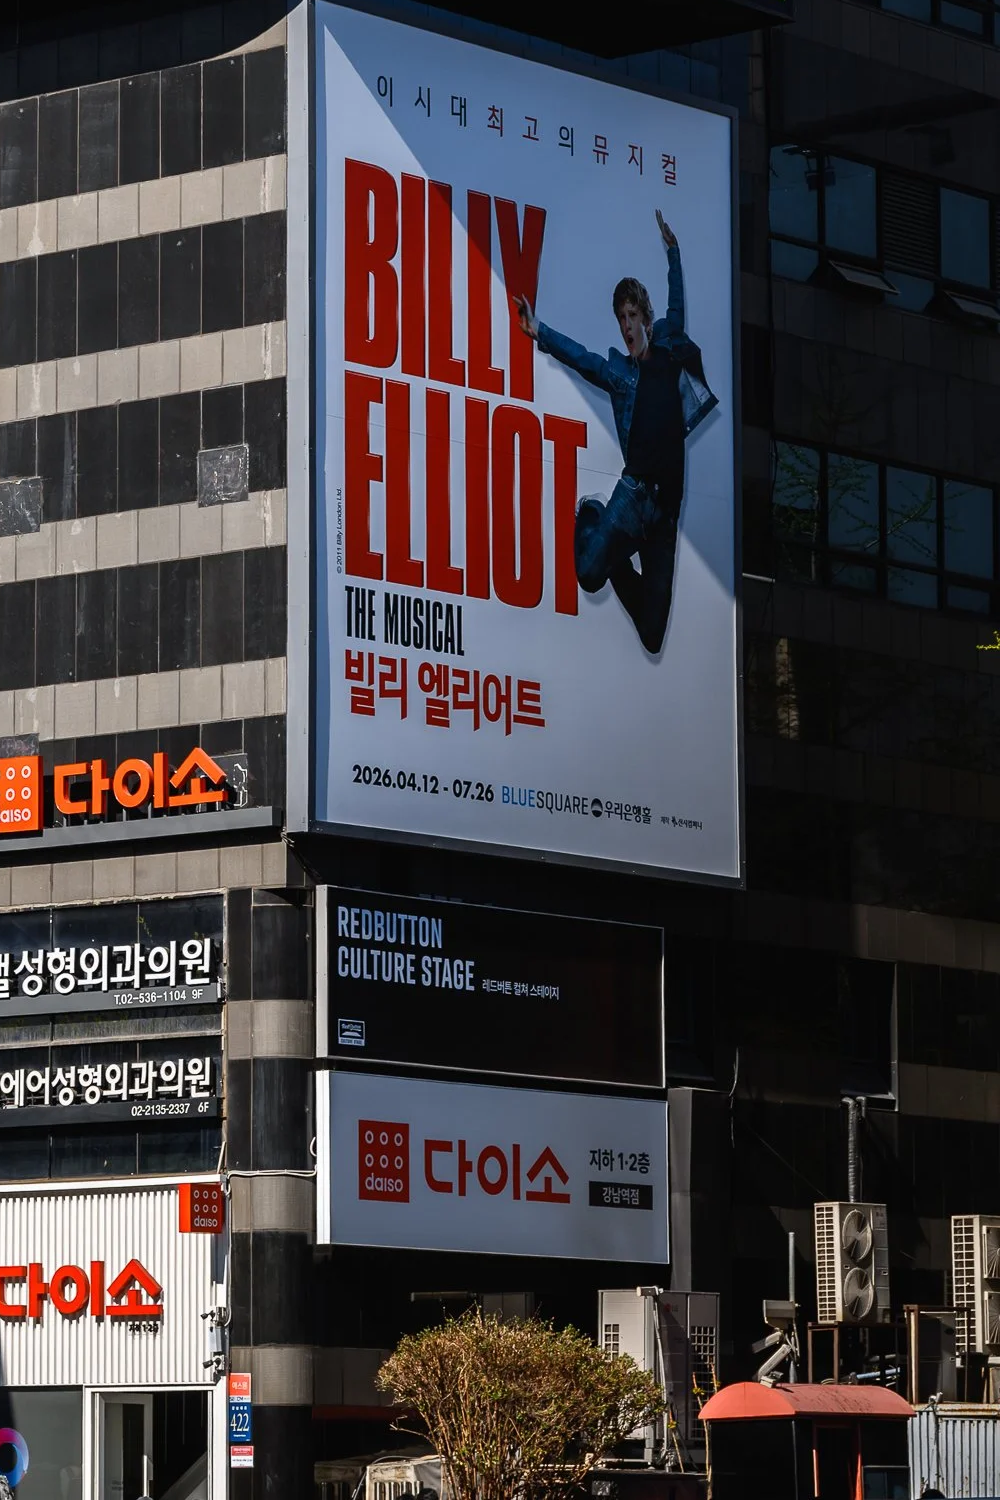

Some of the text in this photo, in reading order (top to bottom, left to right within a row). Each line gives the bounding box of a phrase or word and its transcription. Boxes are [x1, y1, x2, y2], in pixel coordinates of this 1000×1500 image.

[344, 157, 547, 402] BILLY
[344, 370, 588, 616] ELLIOT
[345, 585, 465, 657] THE MUSICAL
[345, 649, 546, 736] 빌리 엘리어트
[54, 747, 228, 815] 다이소
[352, 764, 439, 794] 2026.04.12
[452, 779, 494, 802] 07.26
[502, 786, 589, 815] BLUESQUARE
[604, 800, 652, 825] 우리은행홀
[338, 906, 442, 949] REDBUTTON
[338, 946, 475, 991] CULTURE STAGE
[192, 989, 204, 1001] 9F
[482, 979, 559, 1000] 레드버튼 컬쳐 스테이지
[131, 1102, 209, 1116] 02-2135-2337 6F
[365, 1173, 403, 1192] daiso
[424, 1139, 650, 1204] 다이소 지하 1·2층
[602, 1187, 640, 1205] 강남역점
[194, 1215, 218, 1228] daiso
[230, 1413, 250, 1432] 422
